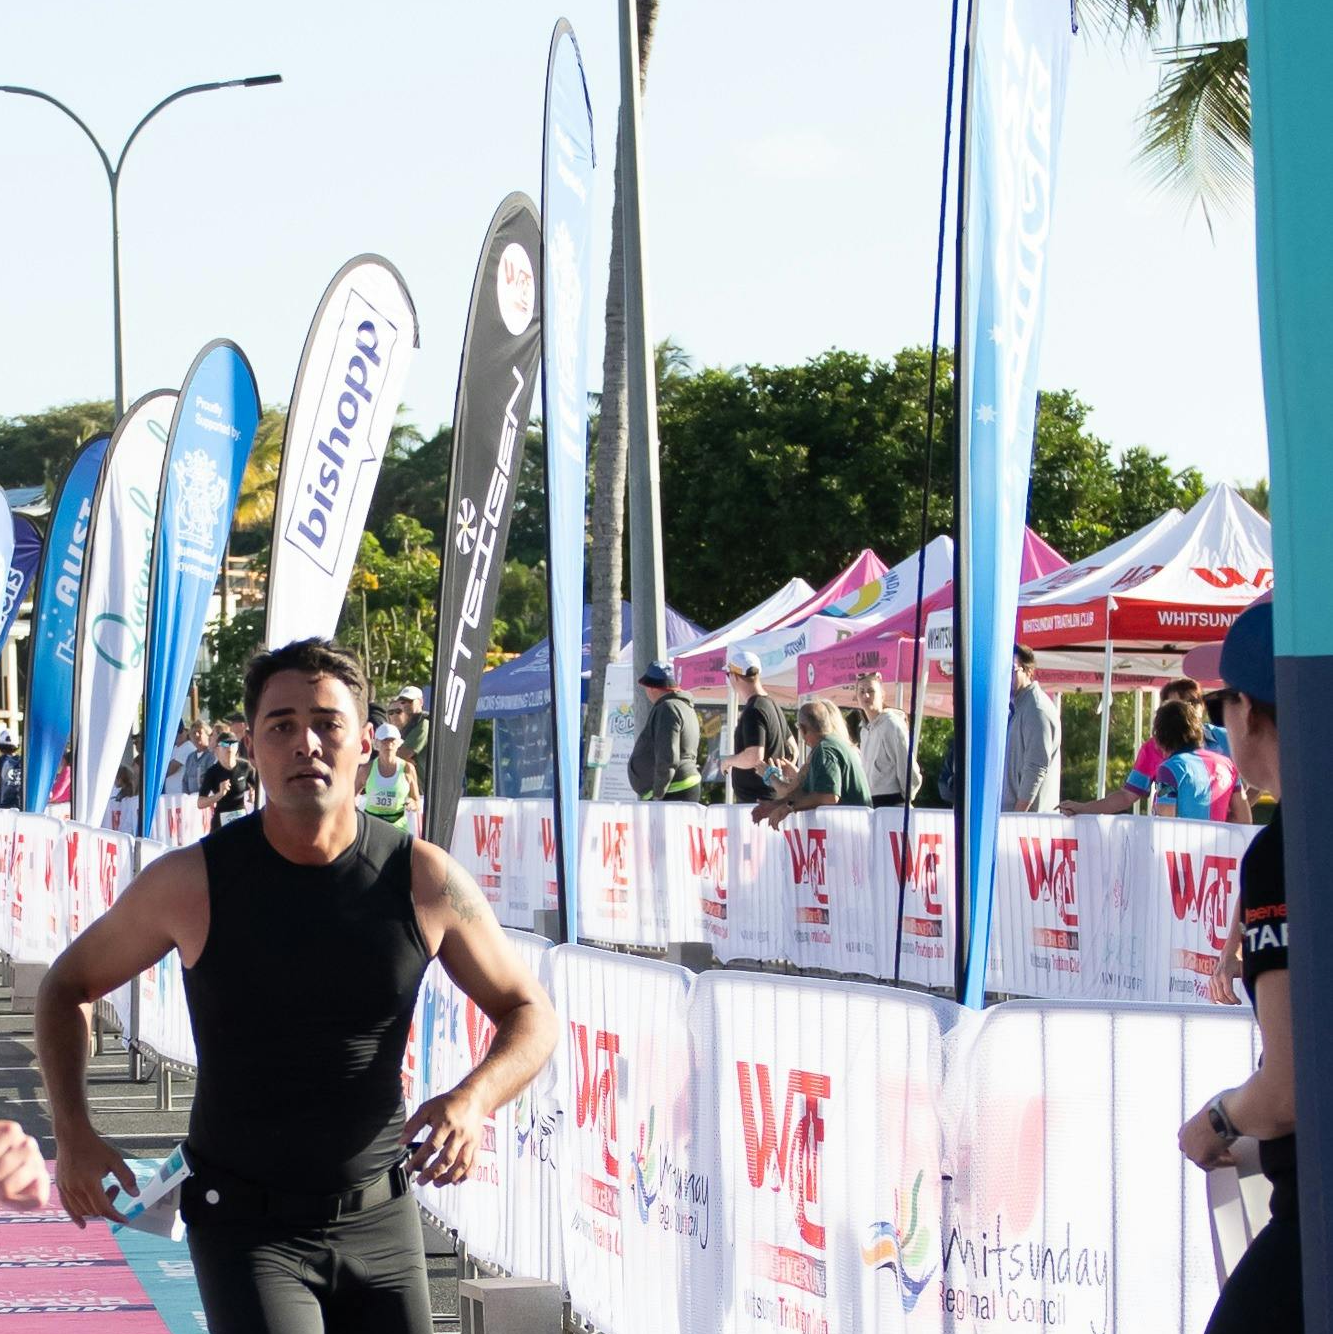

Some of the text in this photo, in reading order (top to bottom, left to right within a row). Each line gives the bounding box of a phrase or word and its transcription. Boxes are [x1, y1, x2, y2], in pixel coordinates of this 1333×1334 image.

[298, 319, 382, 550] bishopp
[444, 365, 526, 733] STEIGEN
[375, 796, 393, 807] 303
